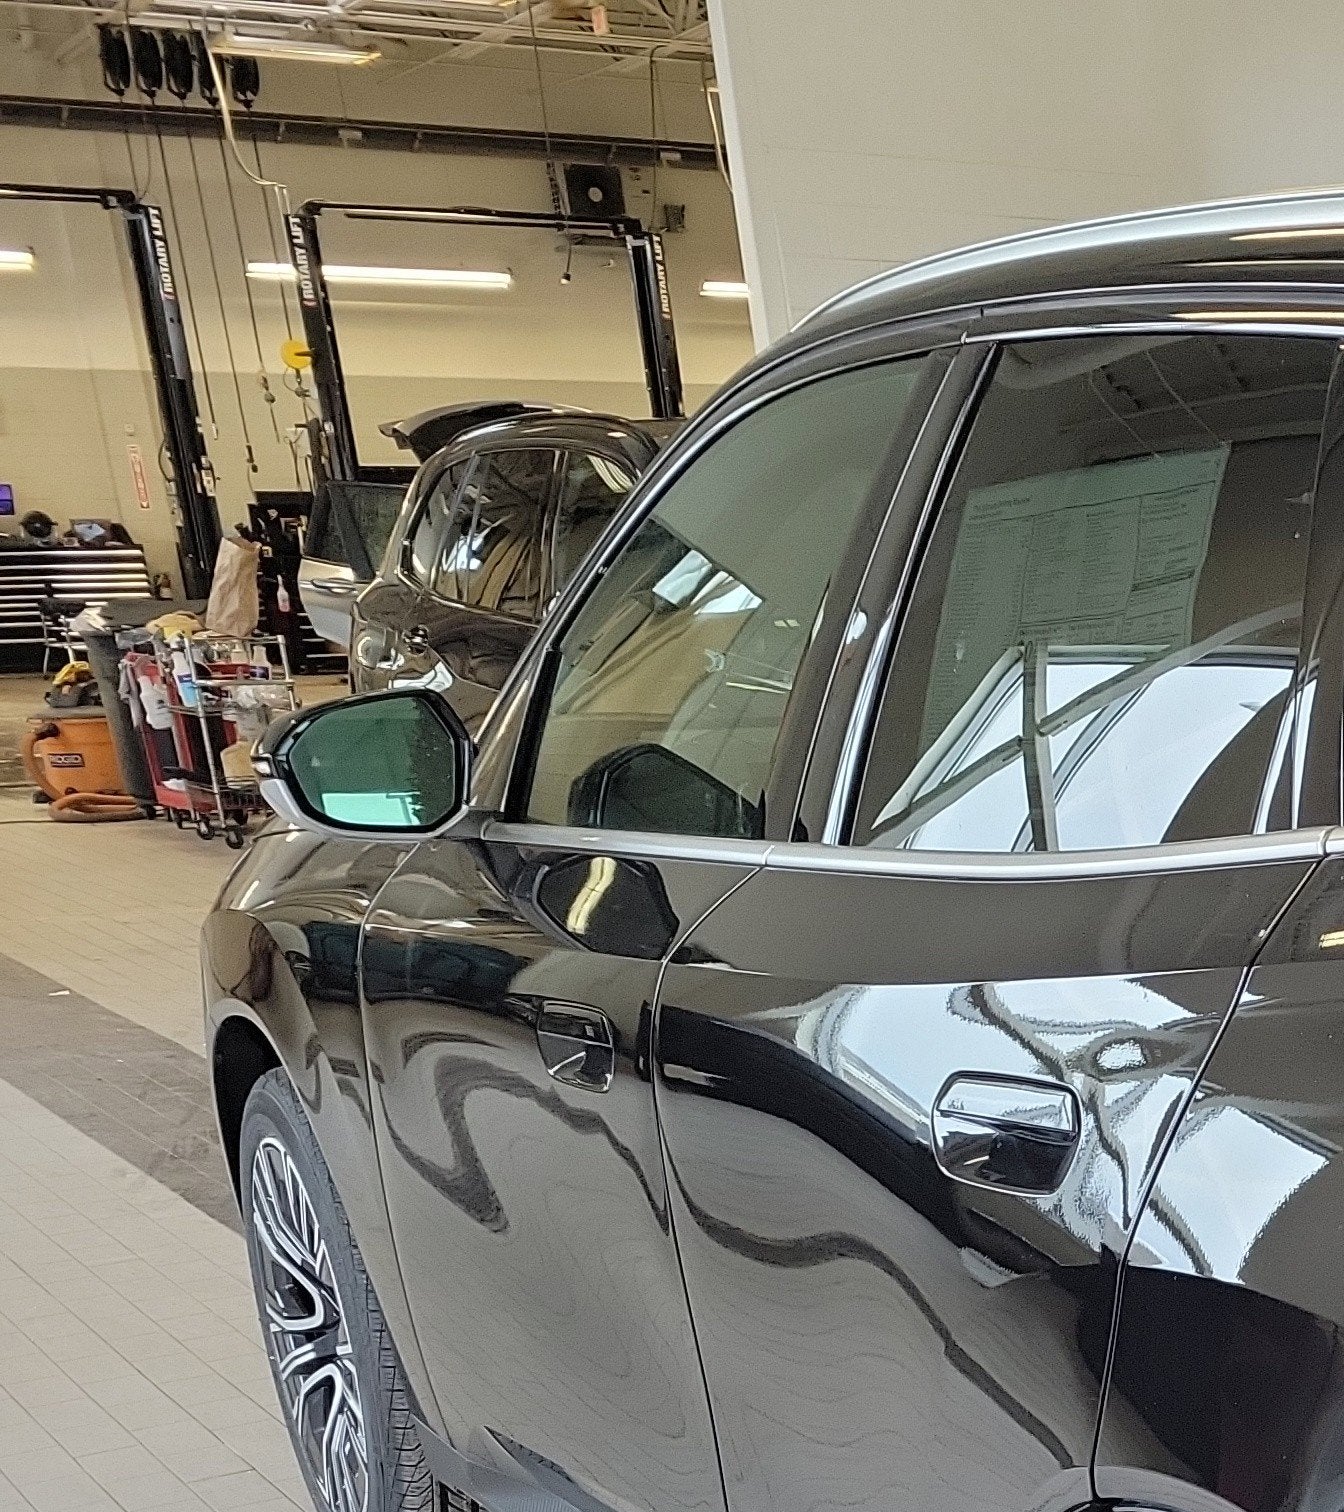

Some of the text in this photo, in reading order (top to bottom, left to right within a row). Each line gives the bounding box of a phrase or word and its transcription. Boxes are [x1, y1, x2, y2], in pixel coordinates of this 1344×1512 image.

[148, 206, 174, 293] ROTARY LIFT
[289, 215, 315, 299] ROTARY LIFT
